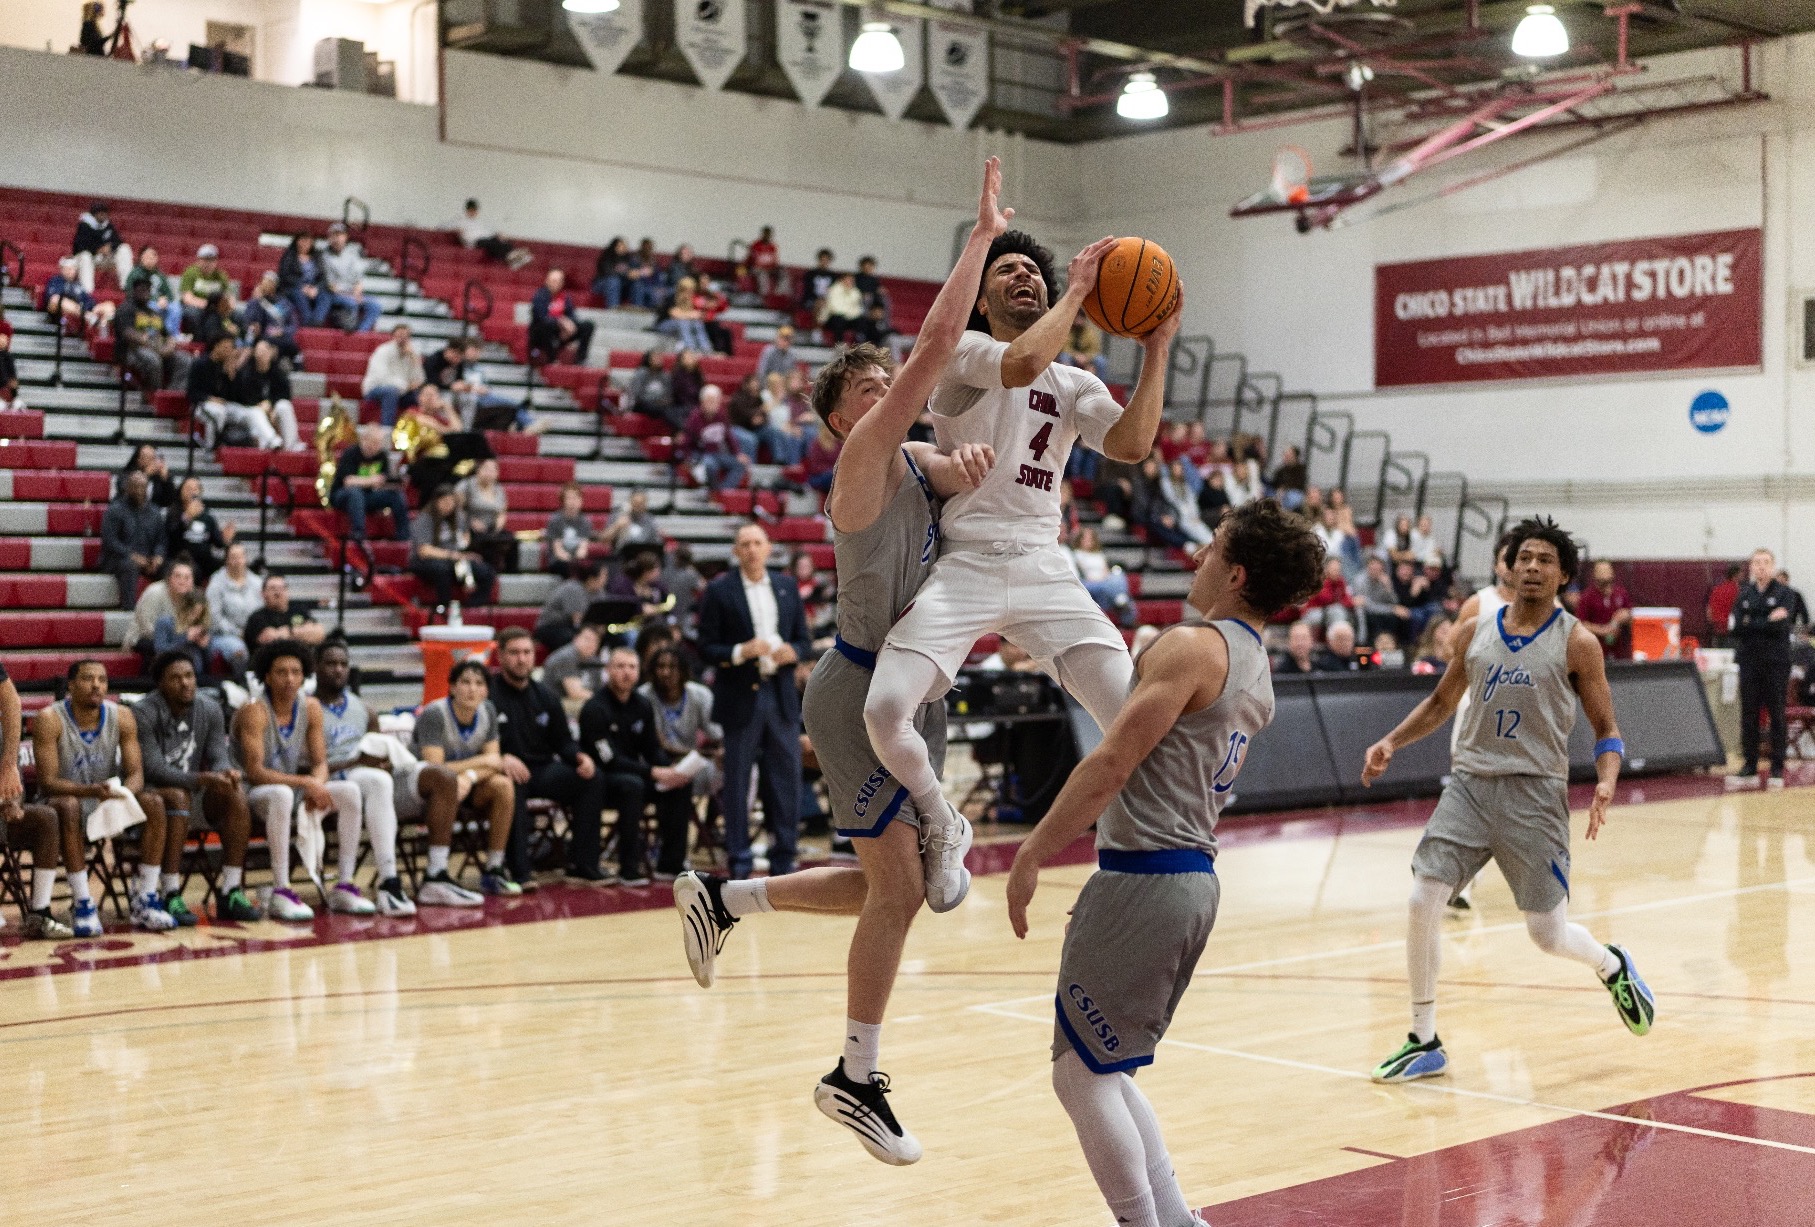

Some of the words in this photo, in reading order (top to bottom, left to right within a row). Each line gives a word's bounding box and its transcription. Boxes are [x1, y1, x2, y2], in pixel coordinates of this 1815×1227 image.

[1394, 289, 1450, 319] CHICO
[1451, 284, 1509, 316] STATE
[1508, 260, 1631, 311] WILDCAT
[1630, 252, 1735, 301] STORE
[1028, 421, 1054, 462] 4
[1015, 463, 1055, 492] STATE
[1483, 663, 1537, 702] Yotes
[1495, 708, 1521, 739] 12
[853, 765, 892, 818] CSUSB
[1067, 983, 1121, 1053] CSUSB
